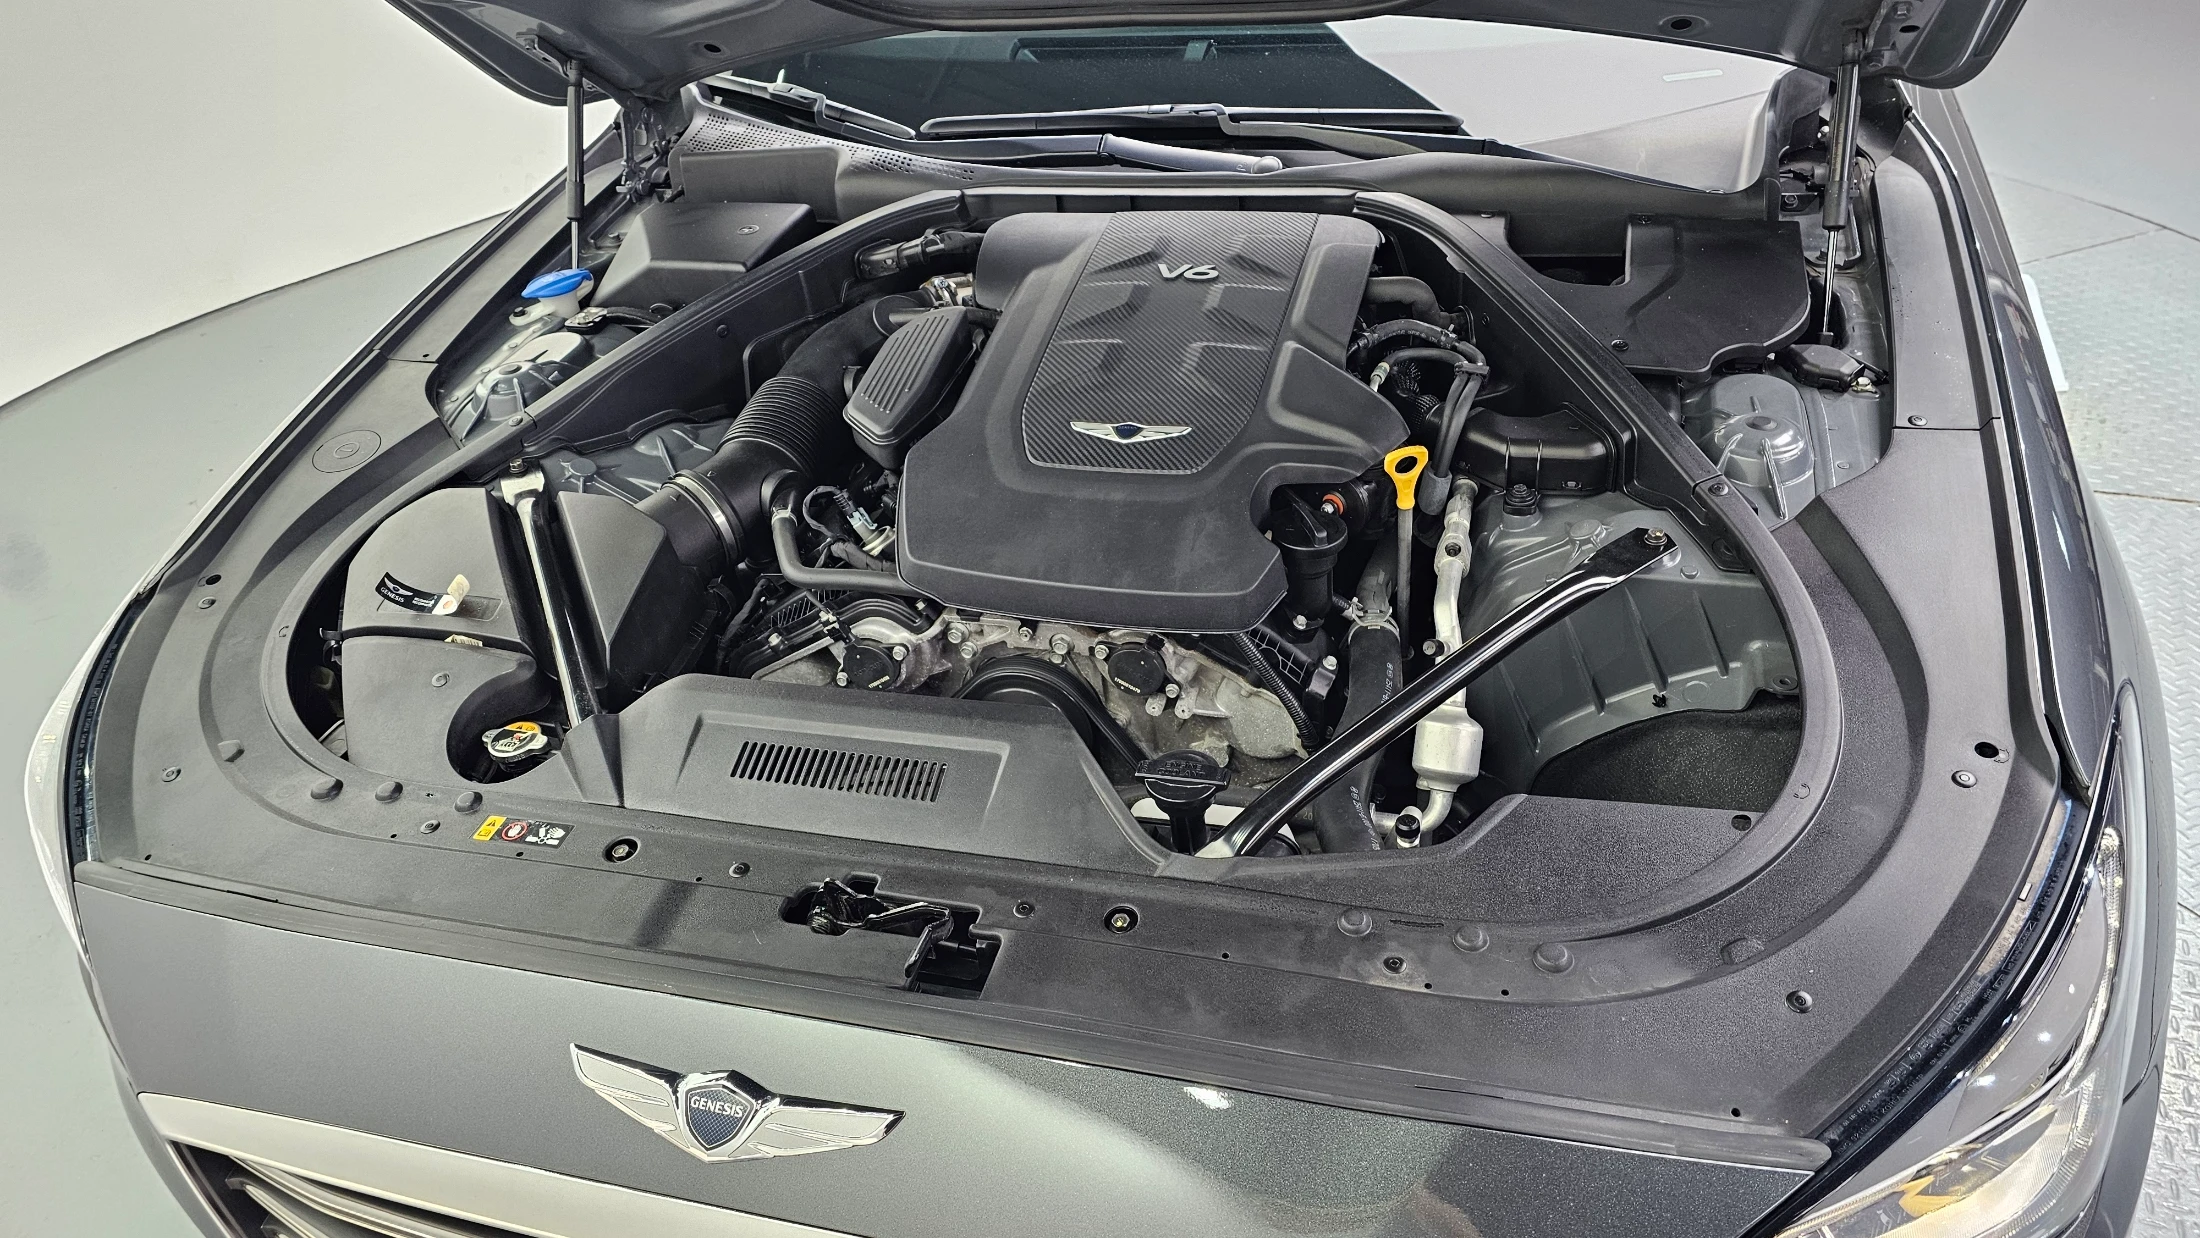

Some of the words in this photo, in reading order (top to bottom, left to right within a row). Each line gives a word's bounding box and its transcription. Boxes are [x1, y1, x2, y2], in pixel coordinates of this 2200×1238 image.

[1157, 263, 1219, 279] V6
[380, 586, 404, 603] GENESIS
[690, 1096, 744, 1118] GENESIS
